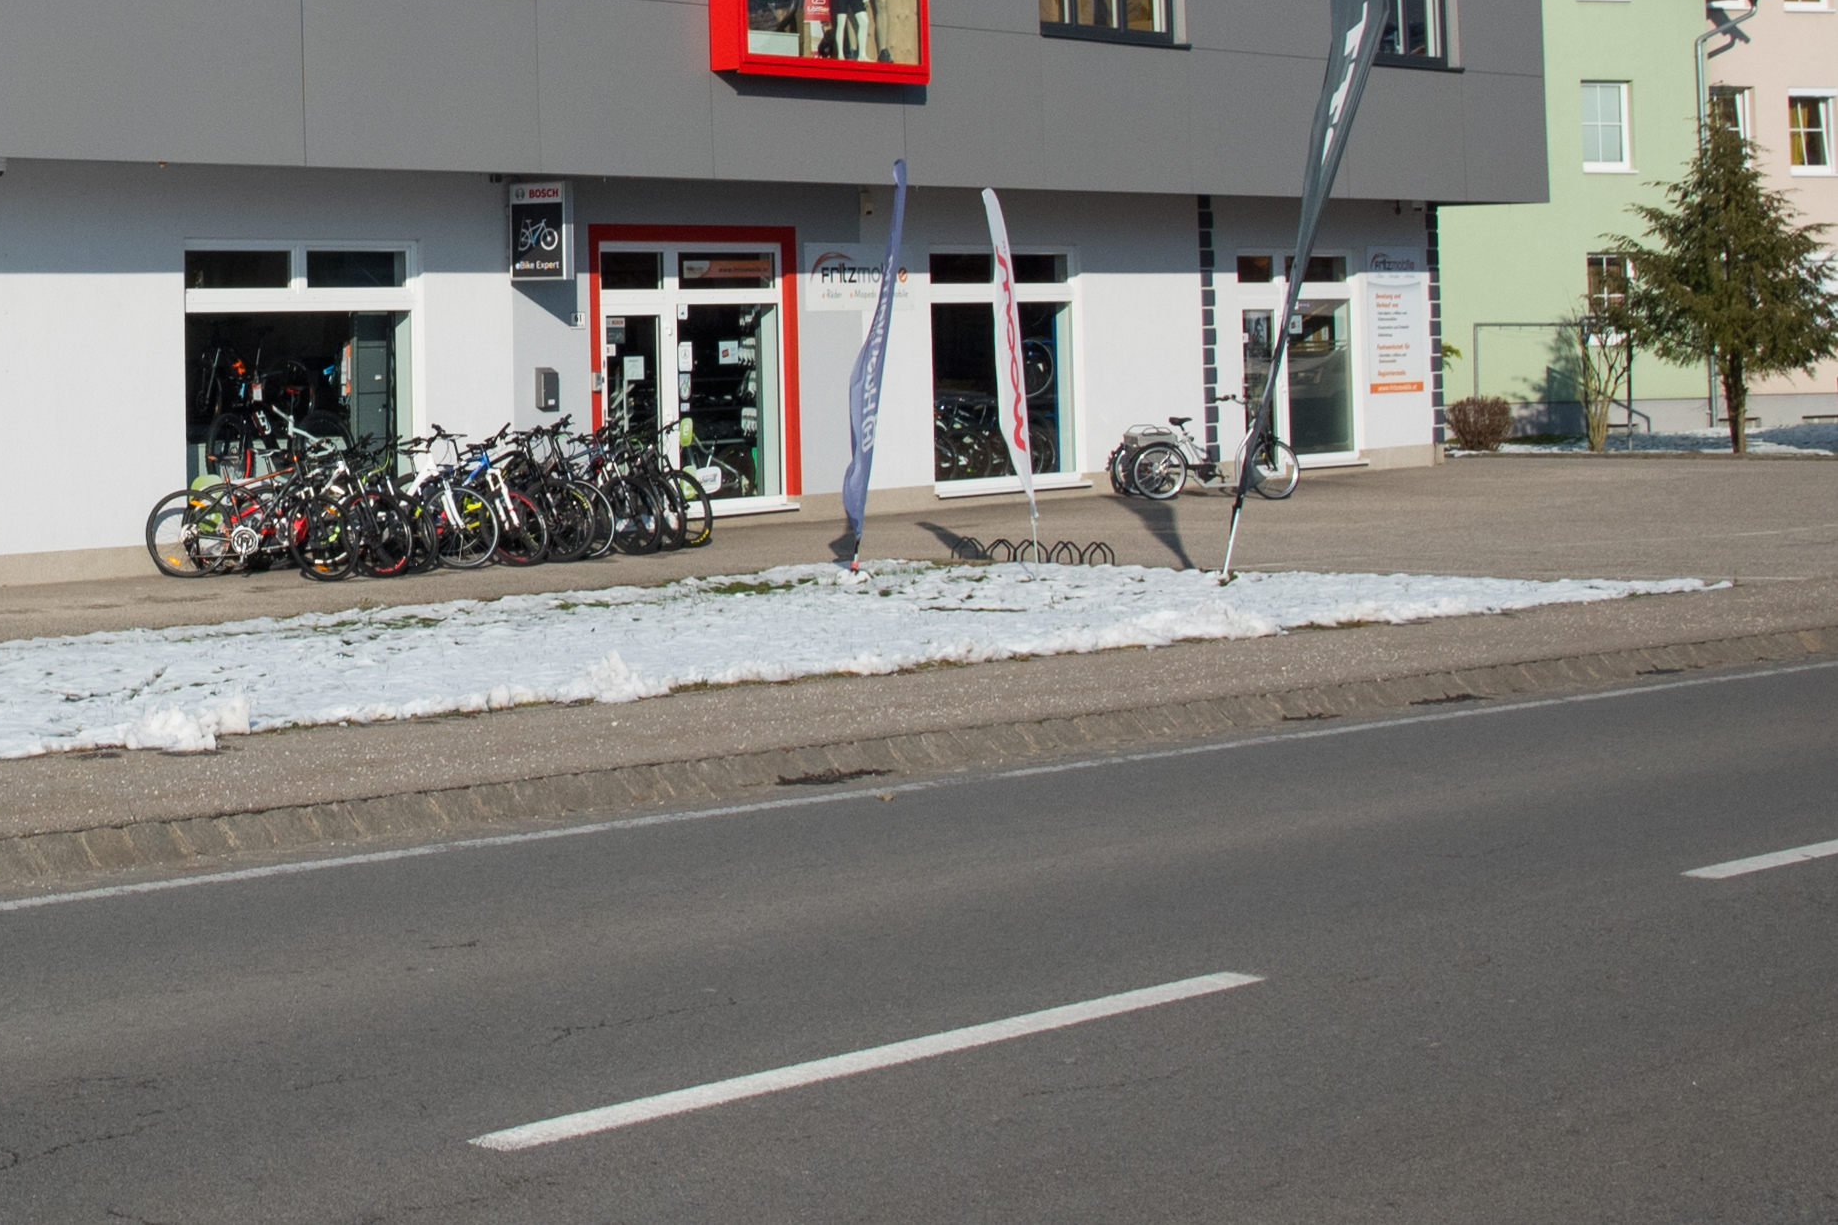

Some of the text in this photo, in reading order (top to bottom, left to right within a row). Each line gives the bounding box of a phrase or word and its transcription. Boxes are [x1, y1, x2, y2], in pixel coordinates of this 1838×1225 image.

[529, 188, 559, 199] BOSCH
[515, 260, 560, 271] eBike Expert
[821, 262, 908, 284] Fritzmoe
[574, 314, 582, 324] 61
